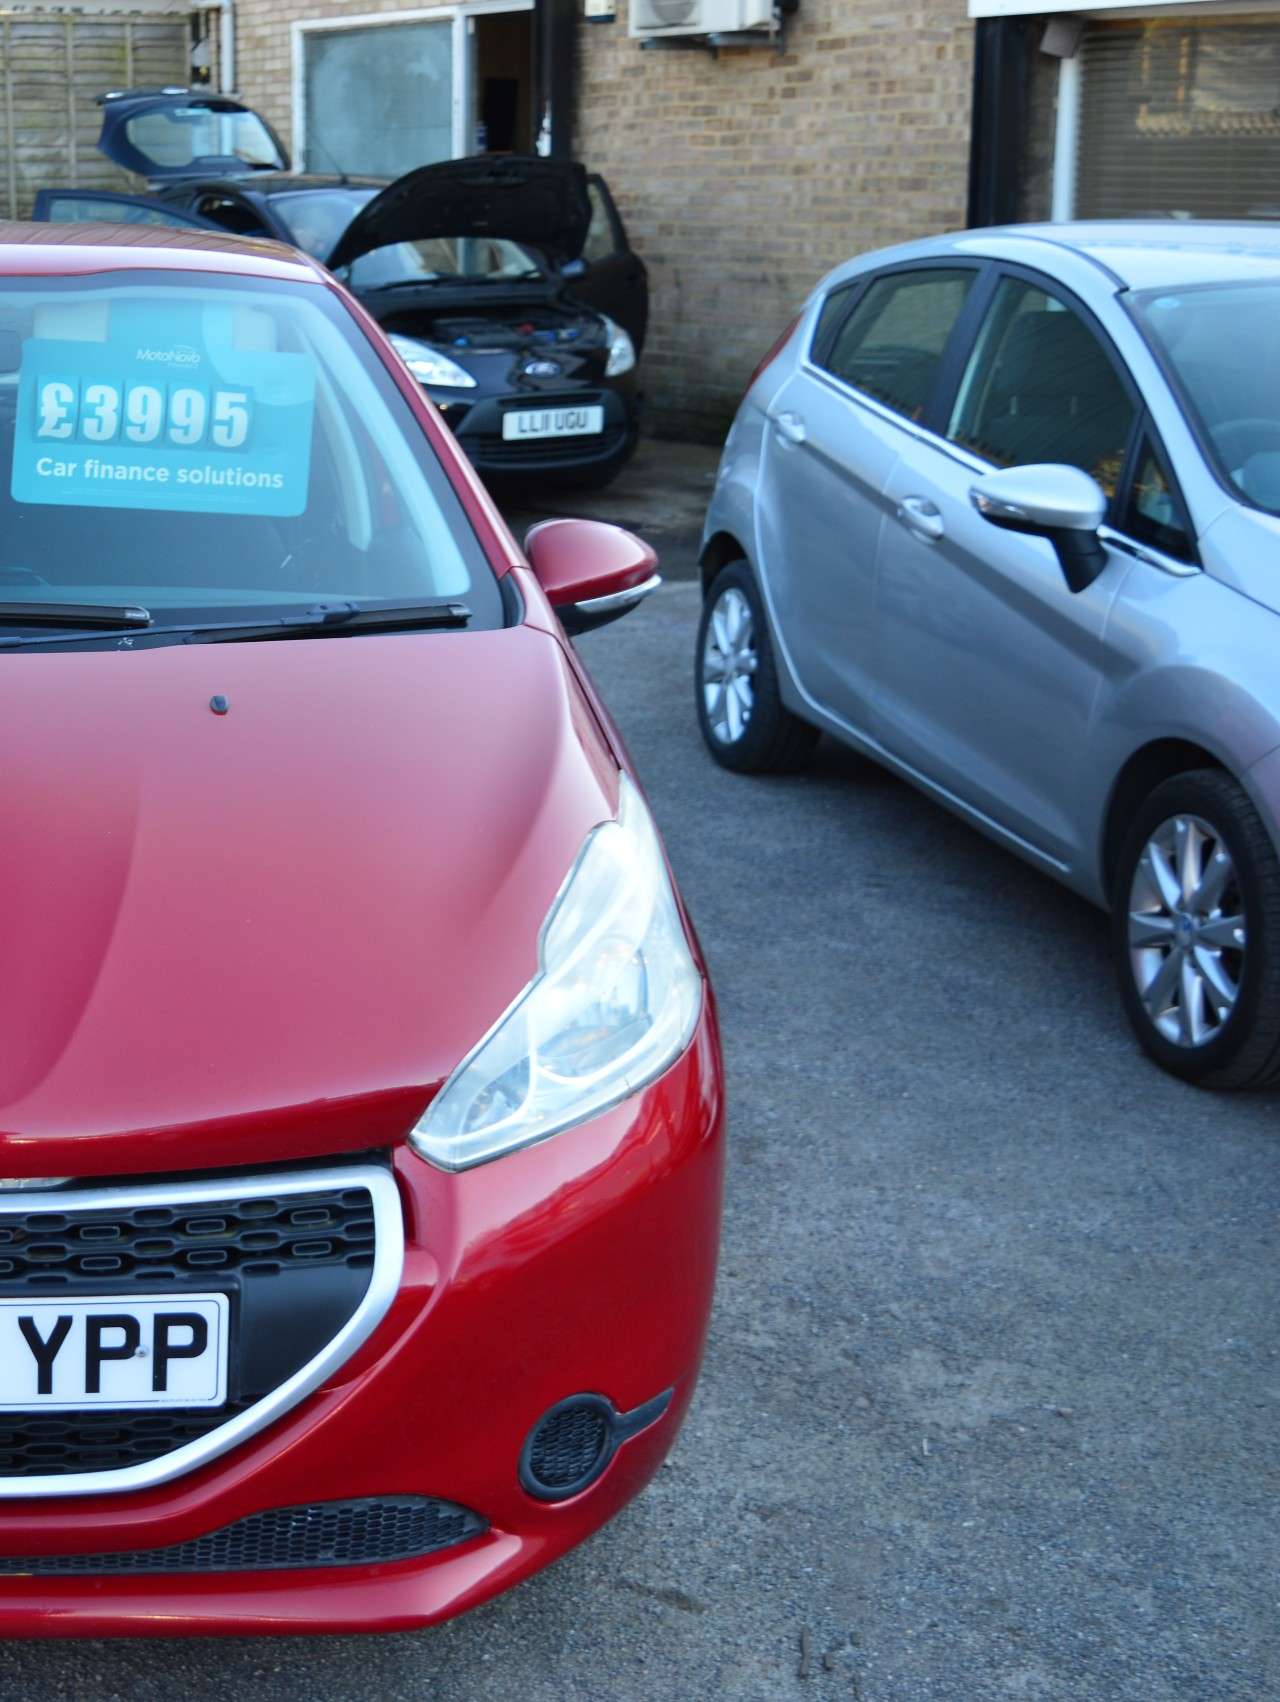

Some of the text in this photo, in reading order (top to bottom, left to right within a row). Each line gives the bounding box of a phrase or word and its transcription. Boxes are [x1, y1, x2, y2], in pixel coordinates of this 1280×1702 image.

[37, 382, 249, 448] £3995
[36, 457, 284, 489] Car finance solutions
[17, 1312, 209, 1395] YPP
